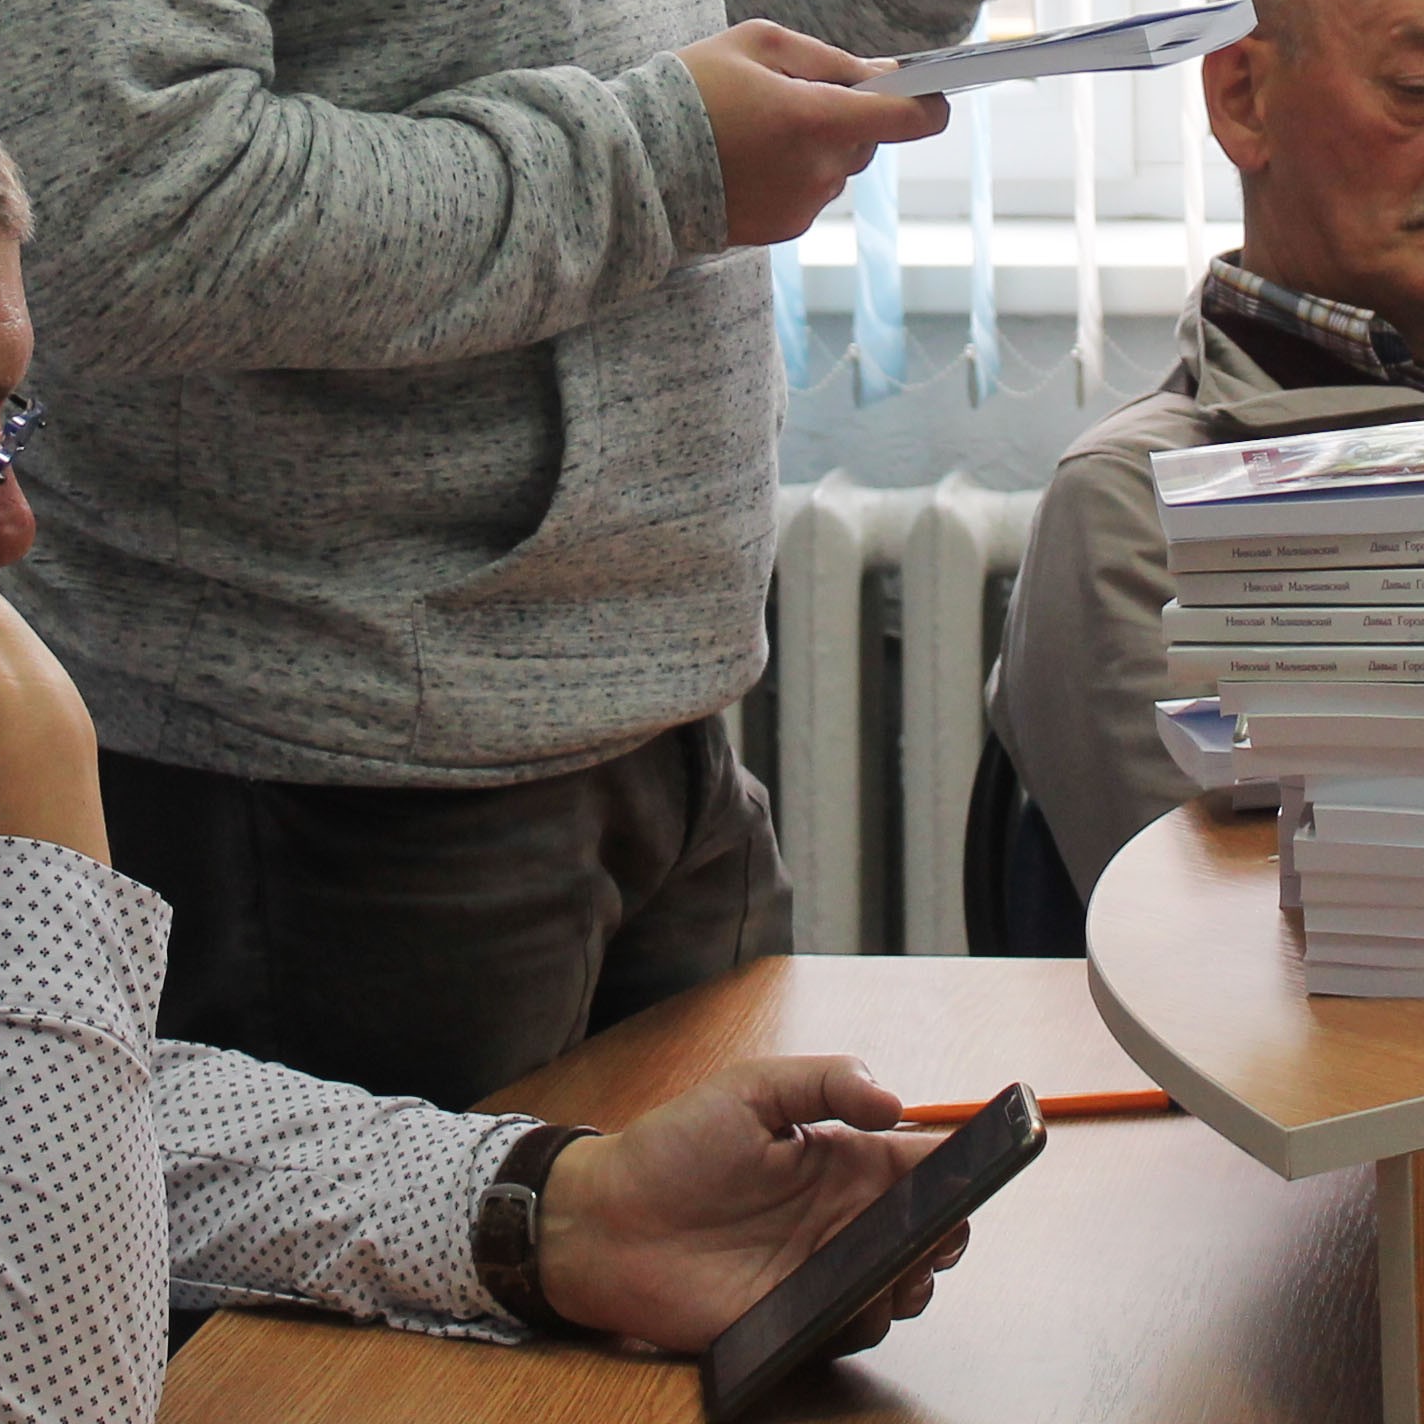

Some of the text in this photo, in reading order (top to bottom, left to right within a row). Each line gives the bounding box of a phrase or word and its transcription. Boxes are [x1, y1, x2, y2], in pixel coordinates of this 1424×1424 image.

[1232, 548, 1271, 558] Николай
[1370, 542, 1400, 553] Давыд
[1243, 582, 1283, 592] Николай
[1381, 579, 1411, 590] Давыд
[1226, 617, 1265, 626] Николай
[1363, 616, 1392, 626] Давыд
[1230, 662, 1270, 672] Николай
[1368, 660, 1398, 671] Давыд
